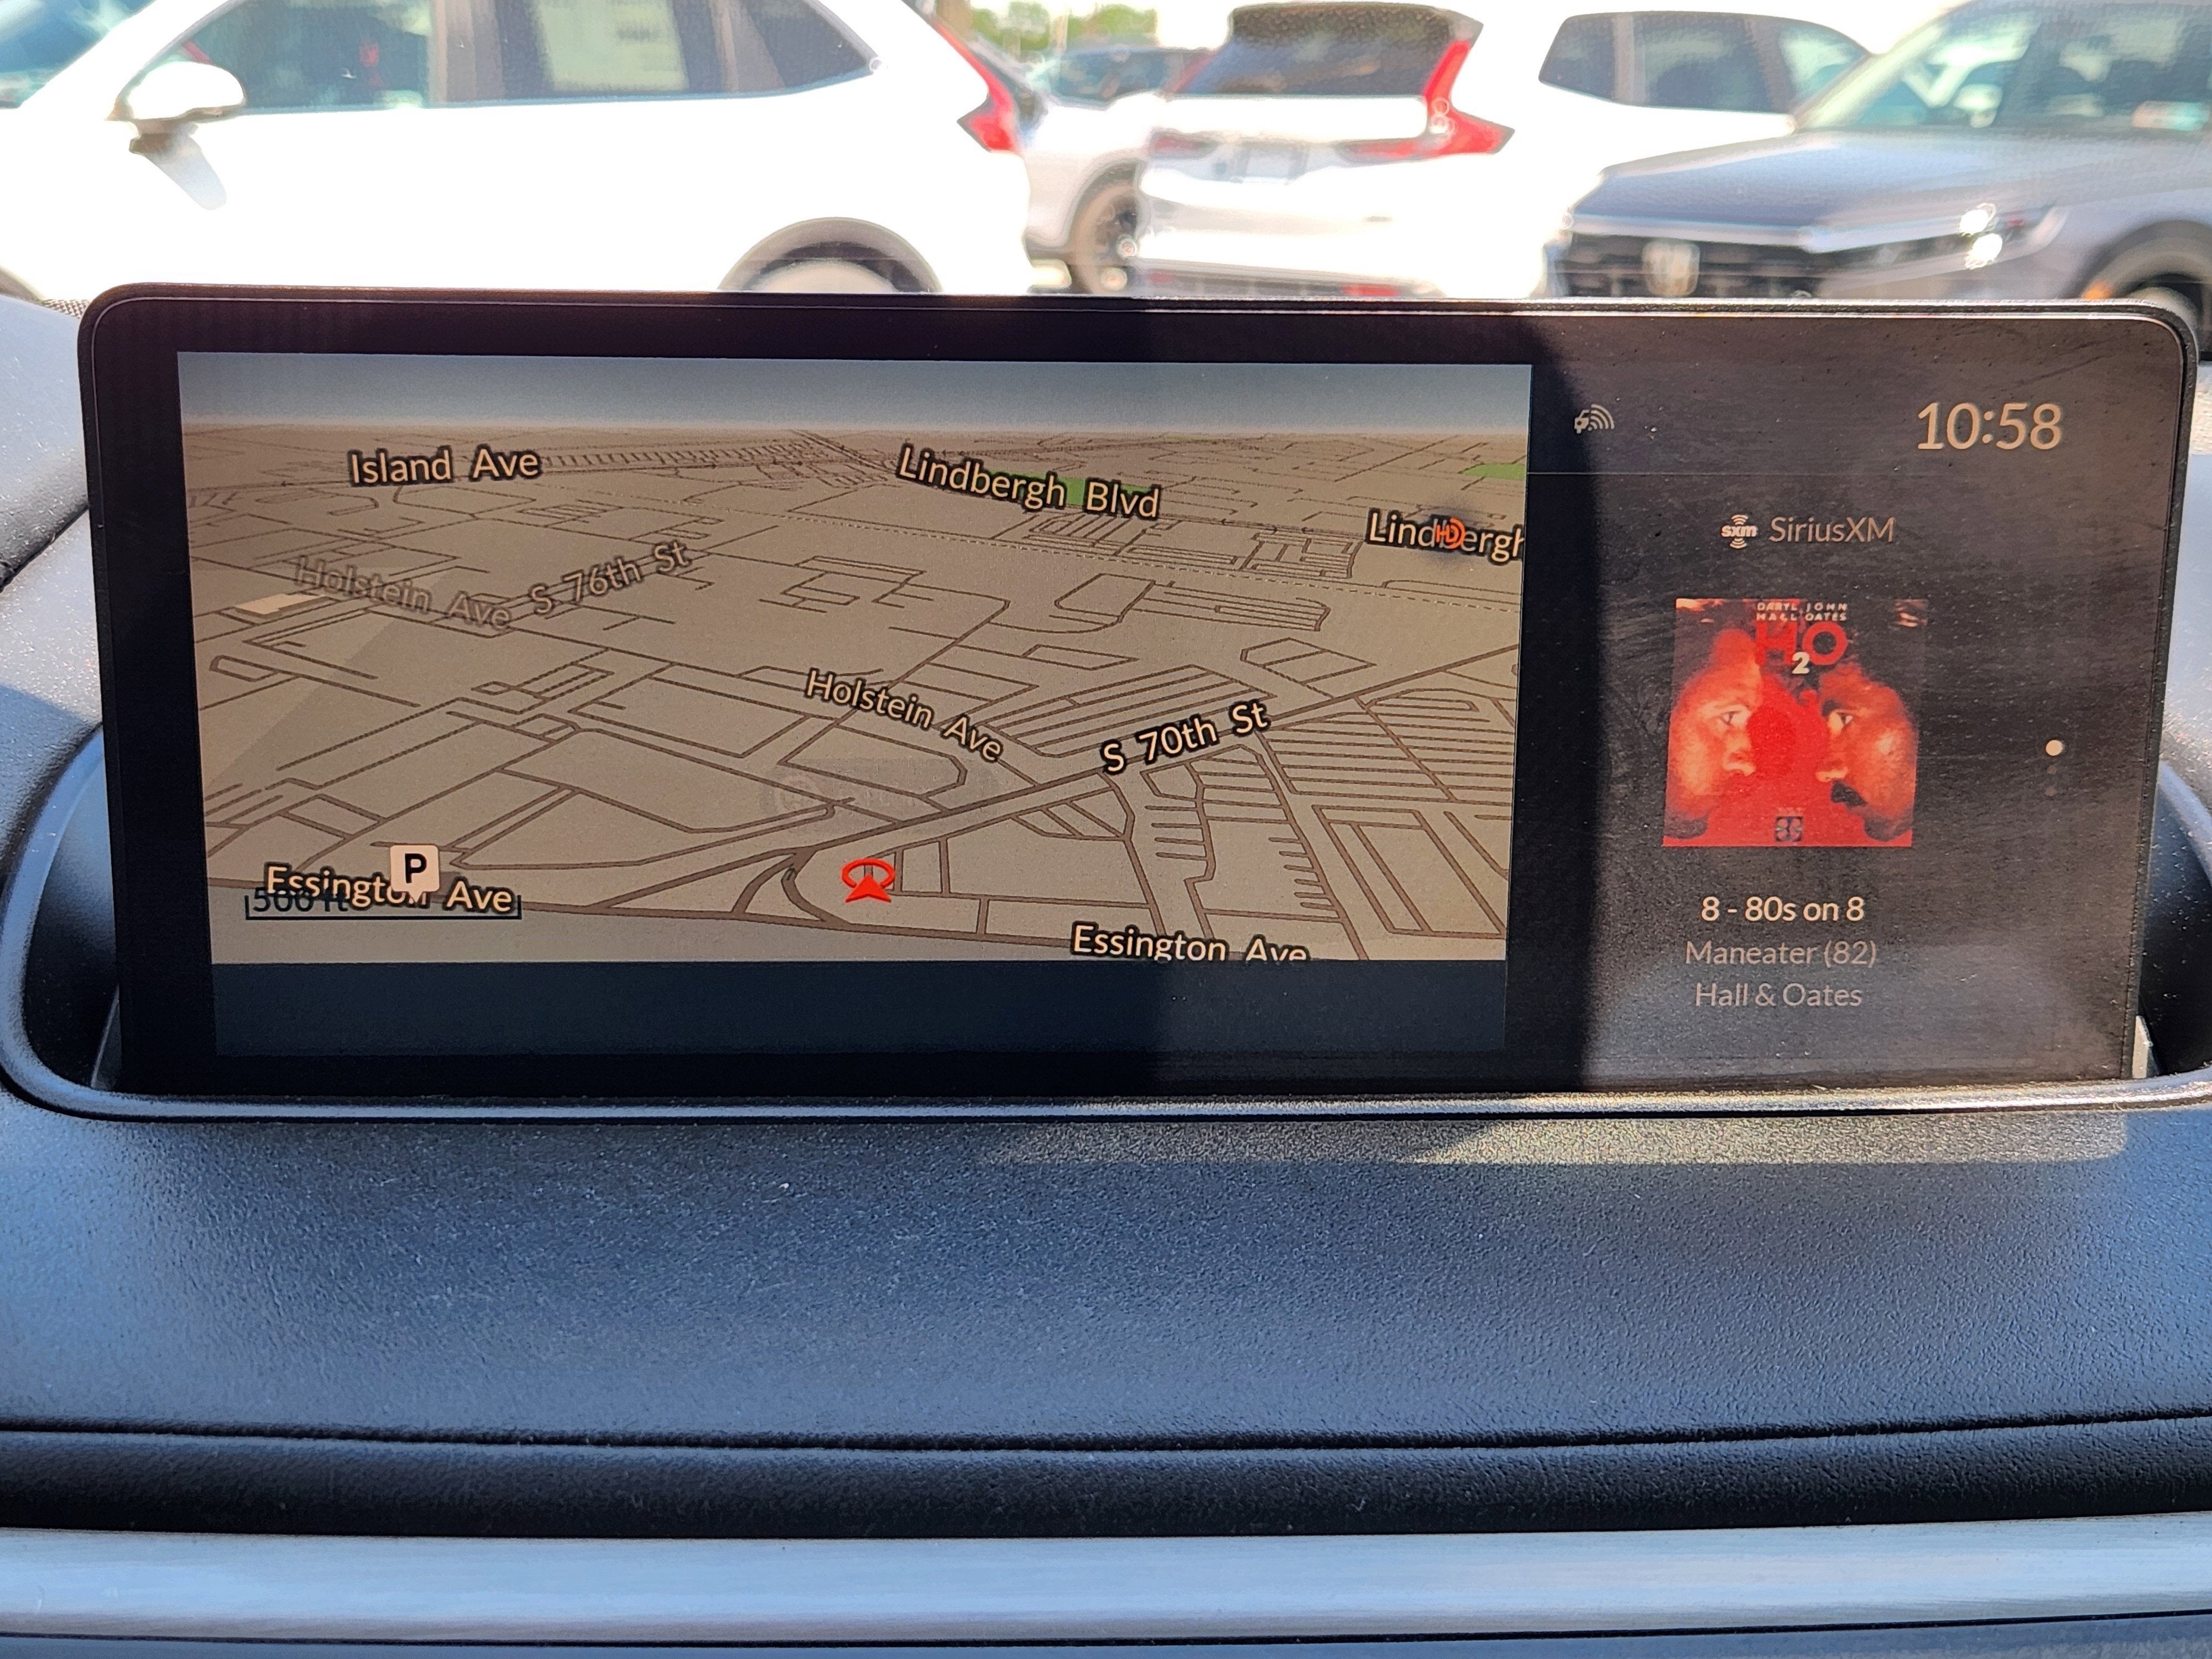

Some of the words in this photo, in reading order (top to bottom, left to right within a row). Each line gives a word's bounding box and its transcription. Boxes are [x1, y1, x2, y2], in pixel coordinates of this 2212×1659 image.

[1917, 402, 2062, 450] 10:58
[350, 448, 452, 484] Island
[472, 447, 539, 479] Ave
[898, 446, 1066, 510] Lindbergh
[1085, 481, 1160, 518] Blvd
[1768, 517, 1896, 543] SiriusXM
[295, 555, 433, 612] Holstein
[446, 592, 512, 630] Ave
[530, 585, 553, 614] S
[564, 557, 643, 603] 76th
[653, 540, 690, 572] St
[1804, 612, 1848, 622] OATES
[1806, 602, 1848, 612] JOHN
[806, 670, 933, 729] Holstein
[942, 716, 1001, 761] Ave
[1103, 742, 1125, 772] S
[1138, 717, 1217, 761] 70th
[1232, 702, 1269, 734] St
[404, 853, 427, 884] P
[267, 865, 427, 907] Essingto
[445, 880, 512, 912] Ave
[1700, 896, 1720, 922] 8
[1744, 896, 1797, 922] 80s
[1802, 902, 1839, 922] on
[1846, 896, 1865, 922] 8
[1073, 924, 1227, 961] Essington
[1245, 937, 1307, 961] Ave
[1686, 940, 1819, 965] Maneater
[1823, 940, 1877, 968] (82)
[1695, 982, 1748, 1006] Hall
[1754, 983, 1777, 1006] &
[1782, 983, 1863, 1006] Oates
